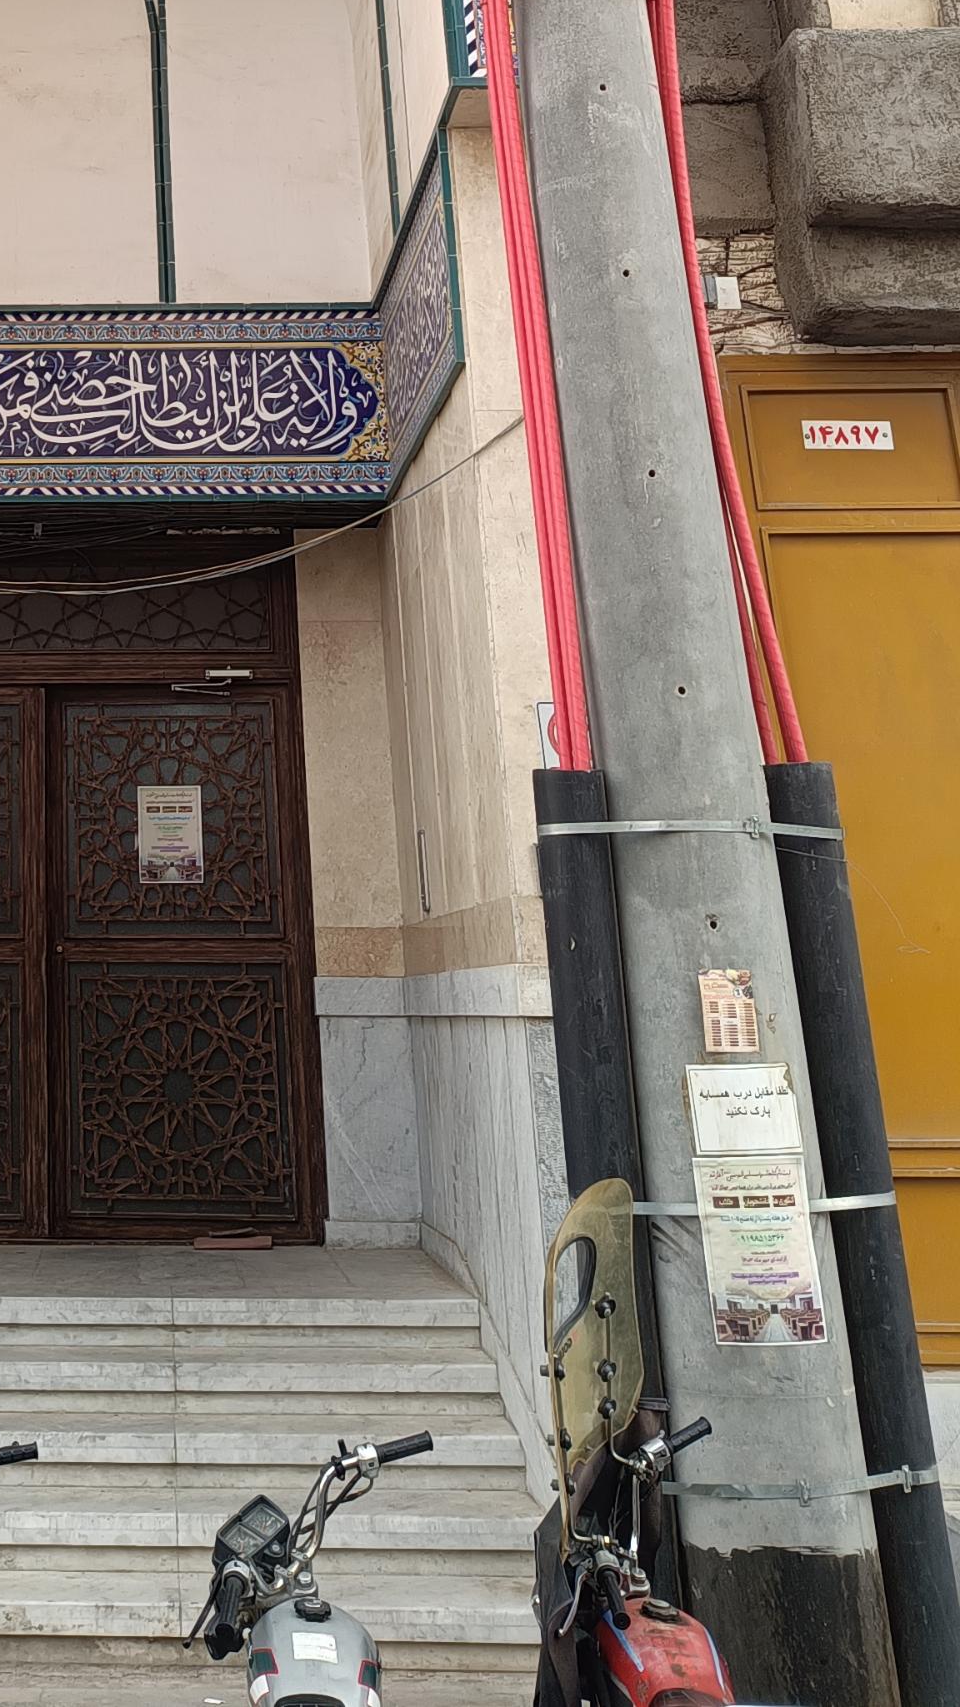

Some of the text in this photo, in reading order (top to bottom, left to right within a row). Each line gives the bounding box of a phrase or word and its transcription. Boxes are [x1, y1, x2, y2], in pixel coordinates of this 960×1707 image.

[809, 425, 879, 445] ۱۴۸۹۷
[699, 1090, 730, 1101] همسایه
[734, 1090, 752, 1100] درب
[754, 1087, 773, 1099] مقابل
[726, 1106, 771, 1118] پارک نکنید
